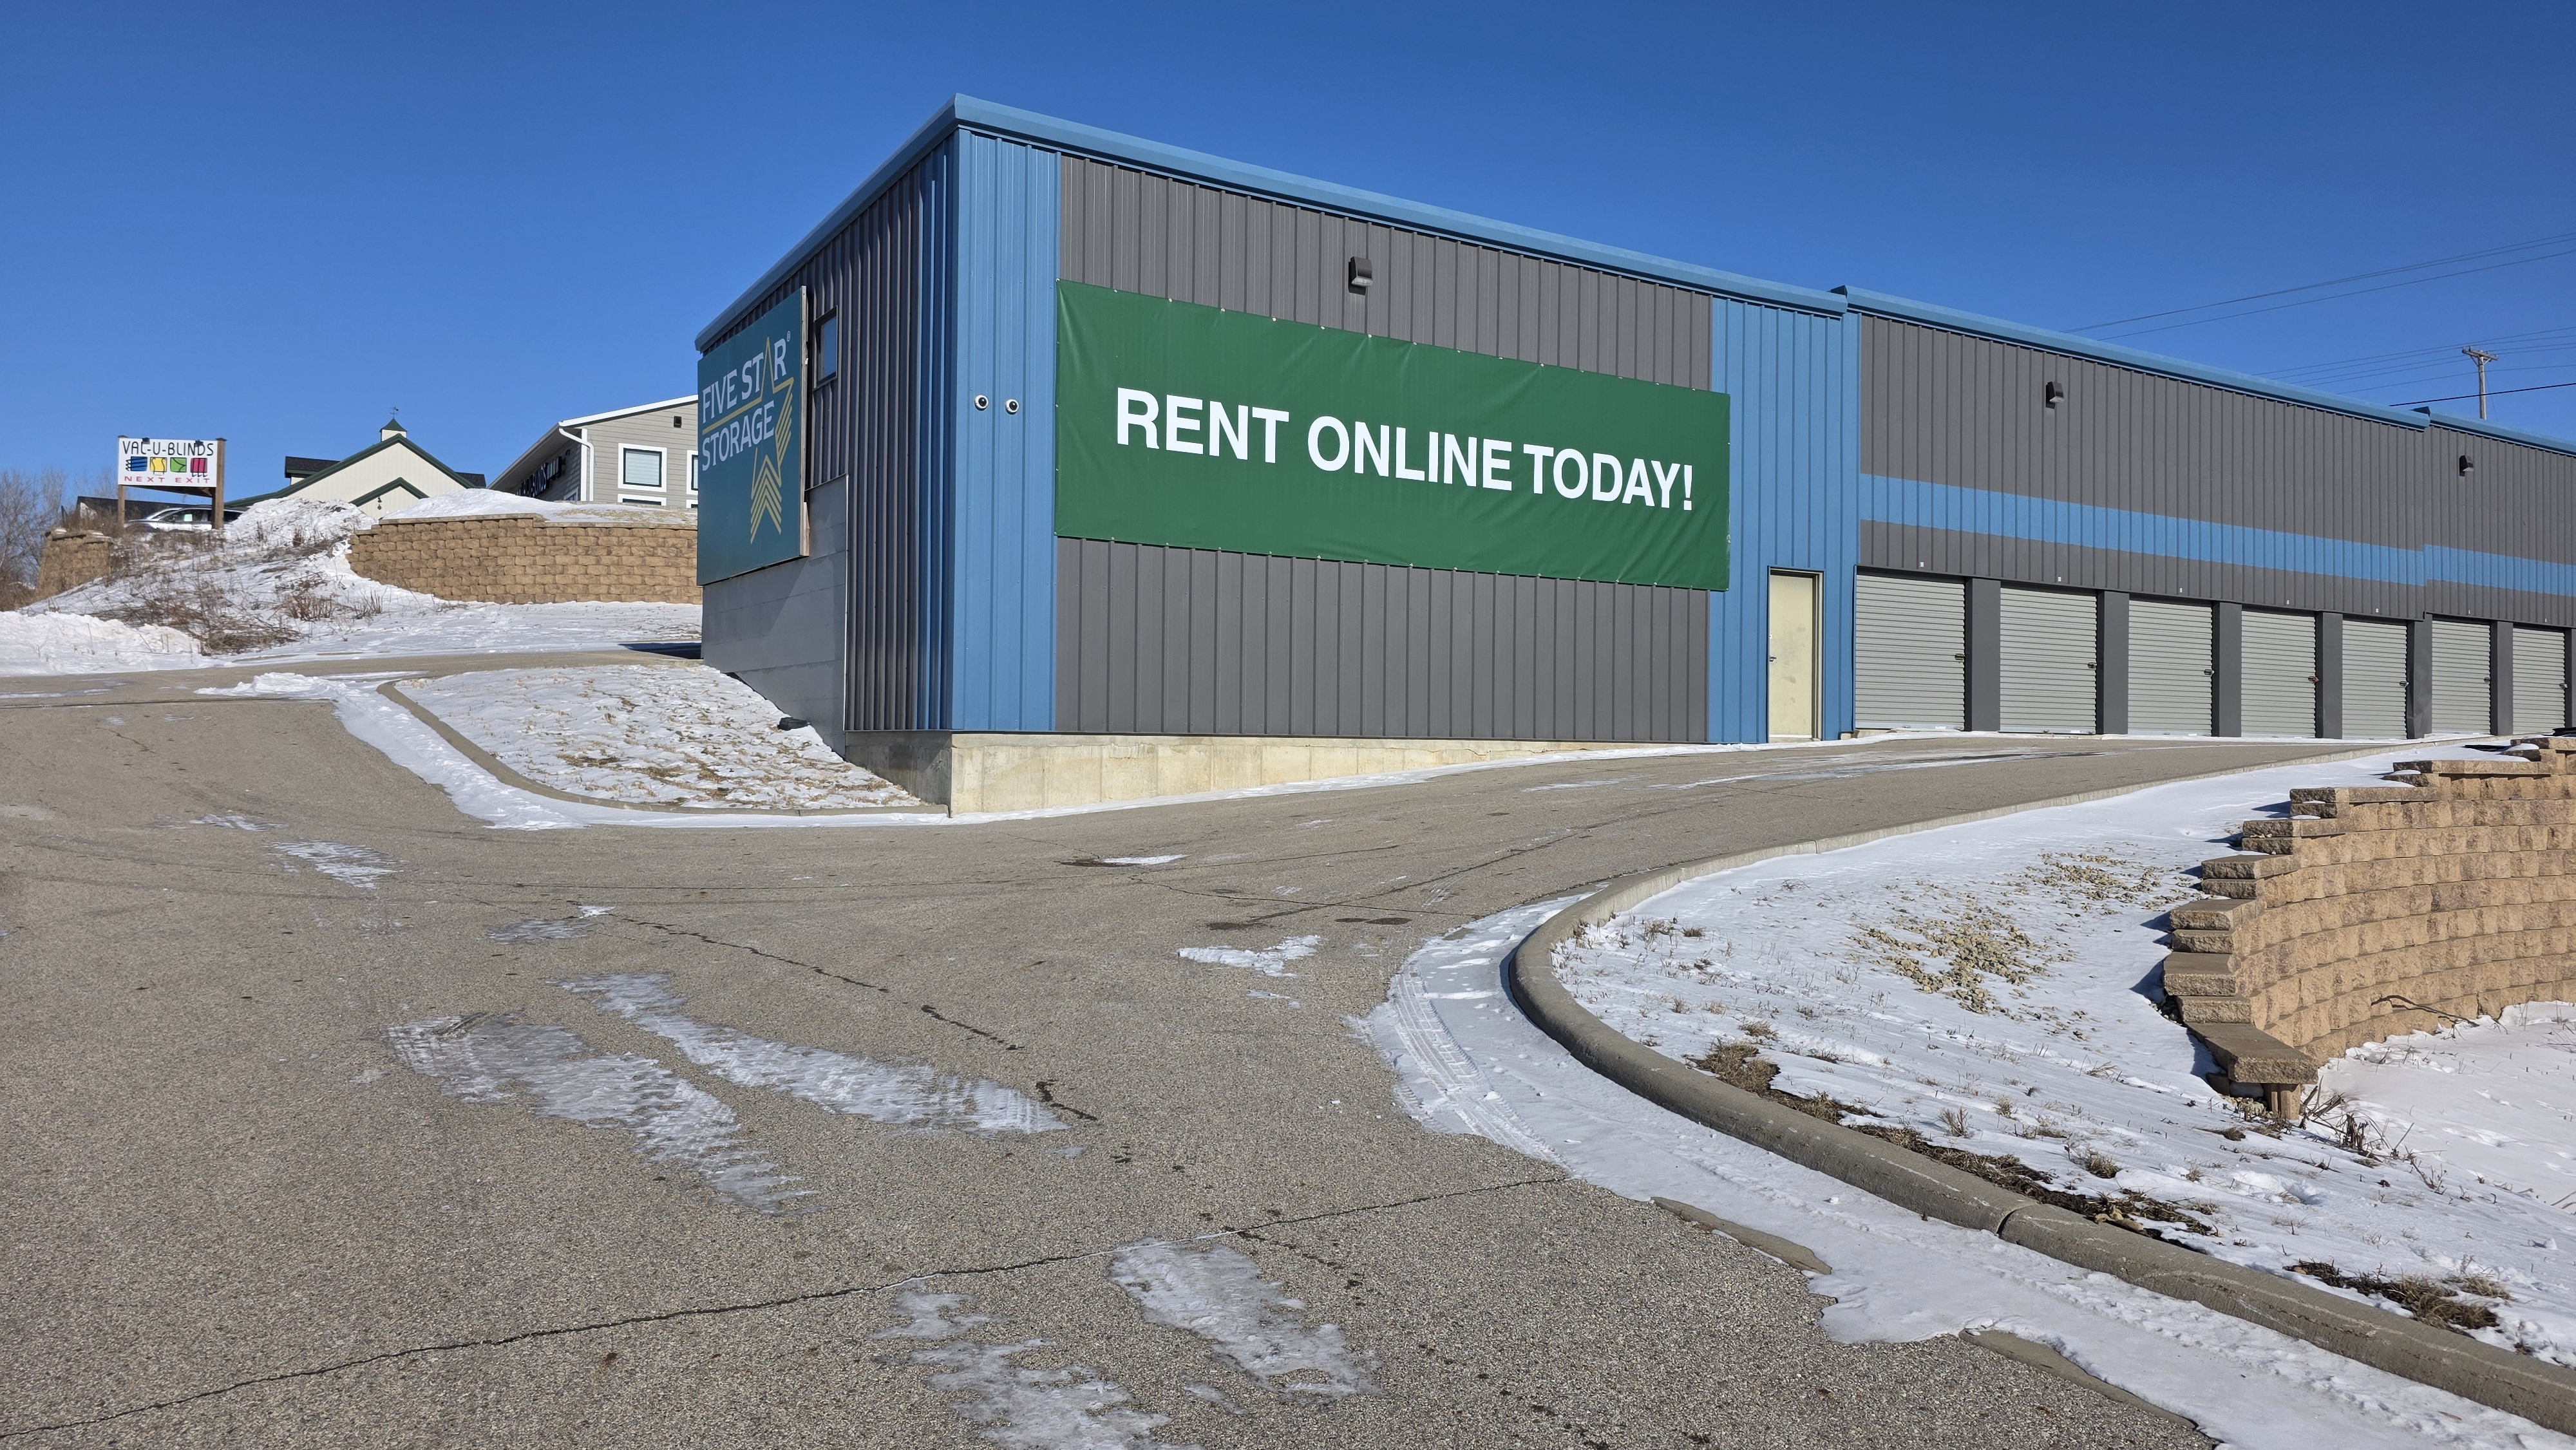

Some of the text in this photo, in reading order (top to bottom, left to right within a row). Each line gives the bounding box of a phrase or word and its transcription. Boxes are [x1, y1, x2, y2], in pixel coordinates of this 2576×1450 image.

[702, 368, 737, 424] FIVE
[122, 440, 214, 457] VAL-U-BLINDS
[702, 400, 775, 471] STORAGE
[1117, 387, 1693, 511] RENT ONLINE TODAY!
